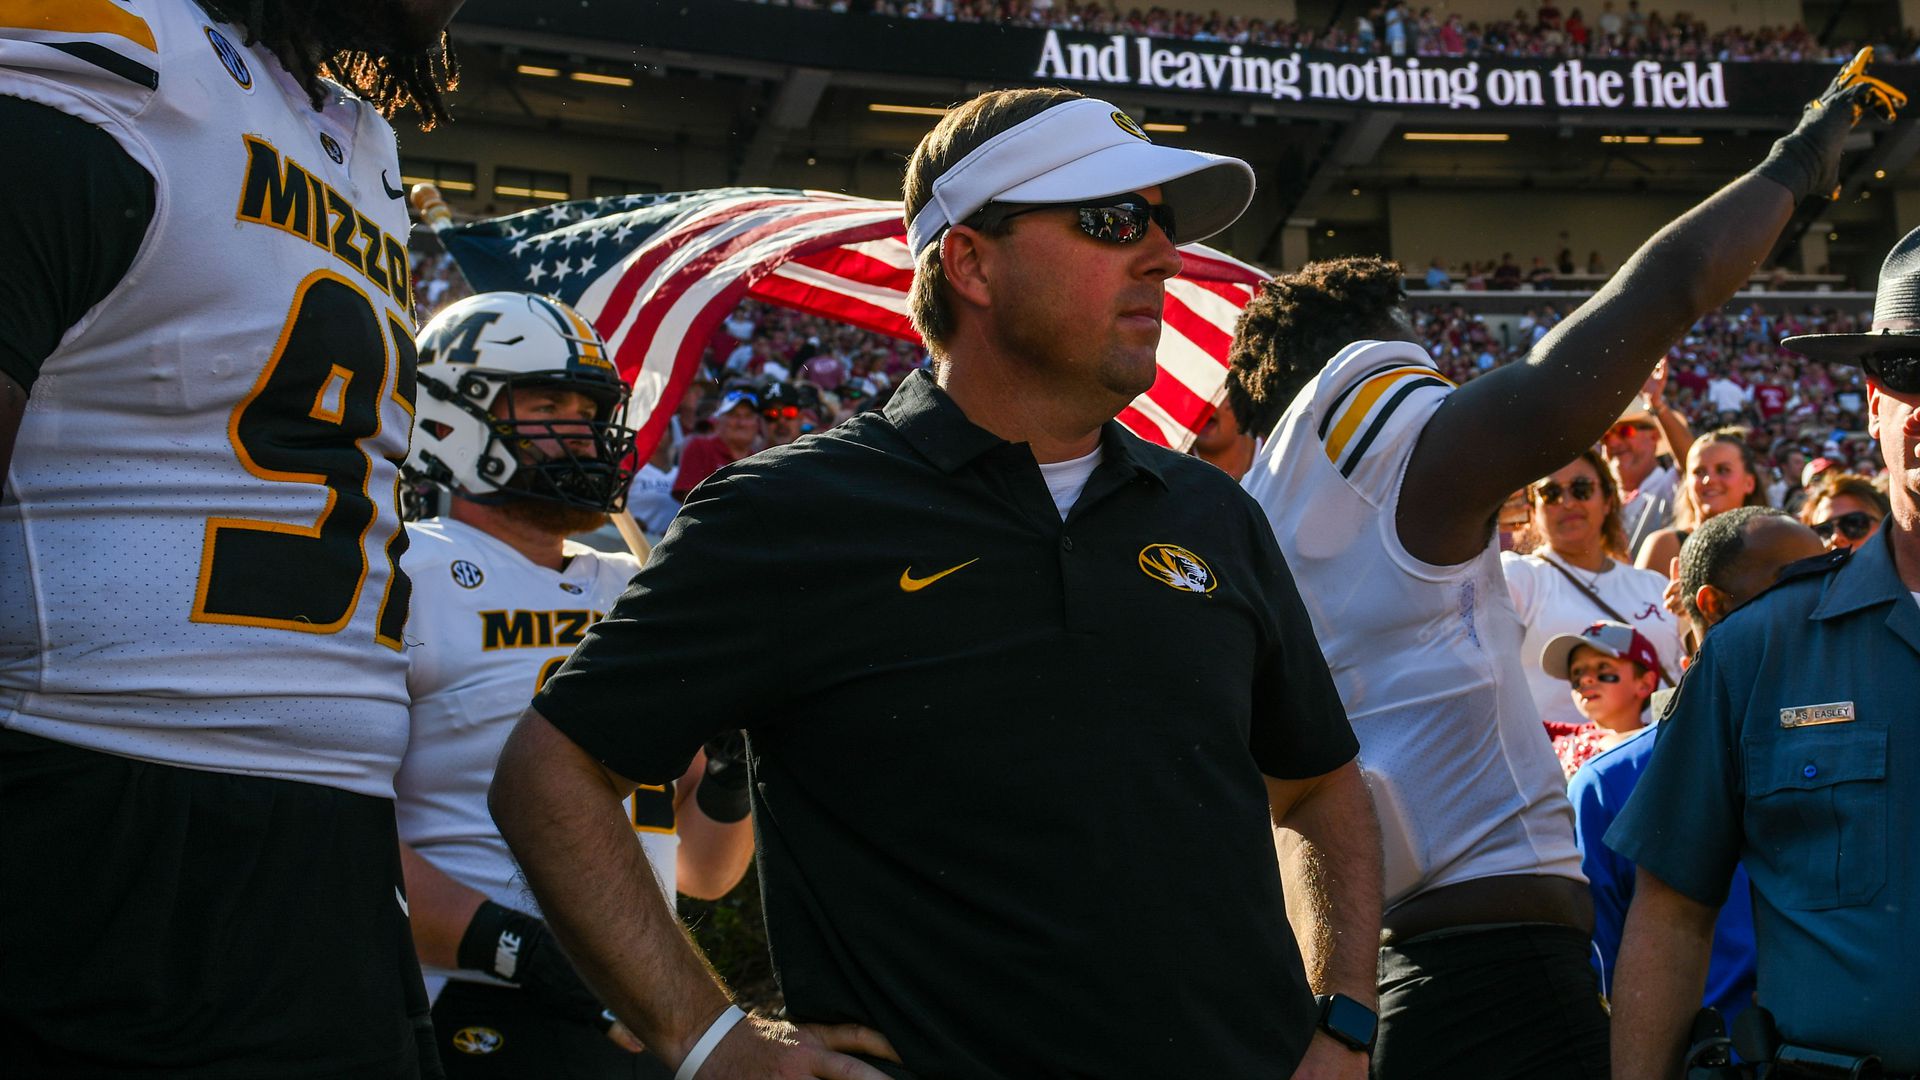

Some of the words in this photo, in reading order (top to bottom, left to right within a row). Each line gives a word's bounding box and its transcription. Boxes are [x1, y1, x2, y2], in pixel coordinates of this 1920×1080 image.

[1034, 29, 1130, 83] And
[1136, 36, 1302, 101] leaving
[1307, 56, 1481, 109] nothing
[1486, 68, 1545, 106] on
[1551, 59, 1625, 108] the
[1630, 60, 1729, 108] field
[236, 133, 417, 329] MIZZO
[417, 311, 503, 367] M
[453, 561, 481, 587] SEC
[478, 609, 606, 651] MIZ
[1814, 707, 1850, 719] EASLEY
